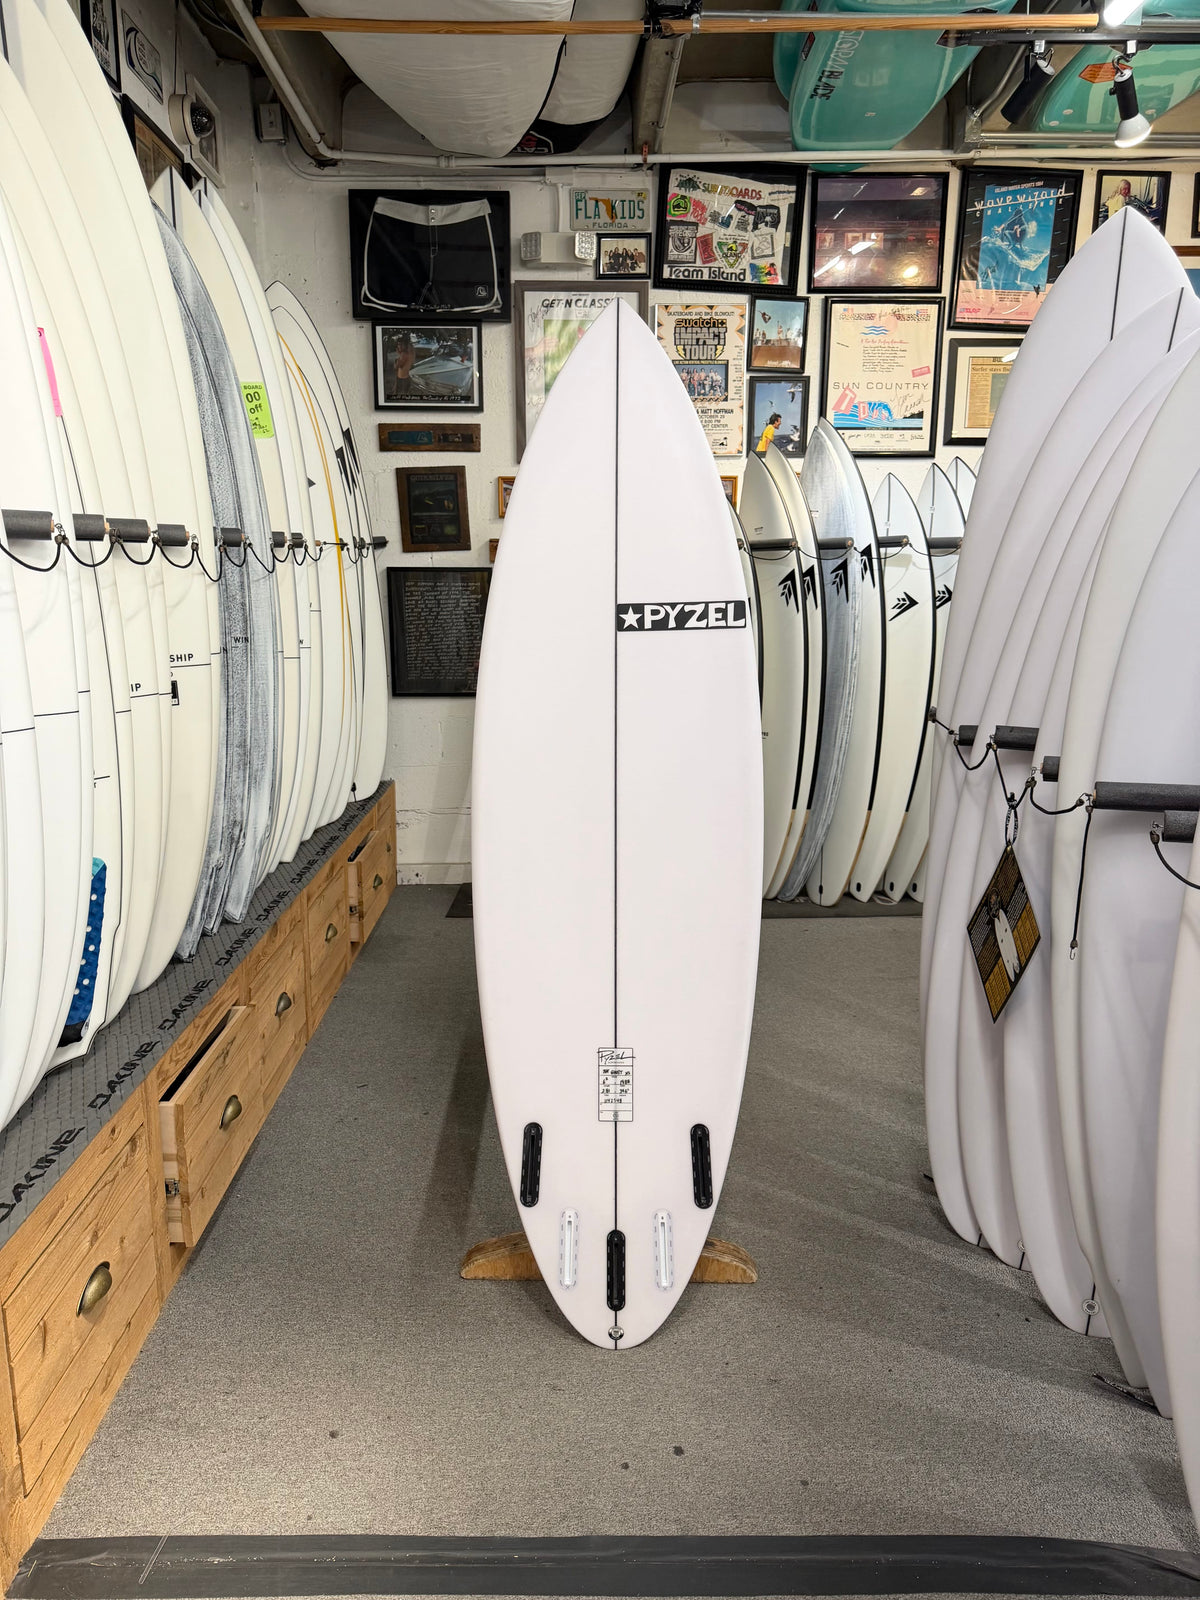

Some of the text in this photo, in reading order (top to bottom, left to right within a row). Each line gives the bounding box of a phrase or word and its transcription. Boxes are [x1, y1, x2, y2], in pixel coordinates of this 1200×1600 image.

[575, 199, 645, 220] FLA KIDS
[668, 266, 747, 281] Team Island
[675, 317, 718, 328] swatch
[674, 327, 727, 346] IMPACT
[684, 345, 716, 360] TOUR
[832, 382, 929, 391] SUN COUNTRY
[249, 403, 263, 414] off
[643, 602, 746, 630] PYZEL
[214, 925, 260, 967] DAKINE
[157, 978, 214, 1031] DAKINE
[87, 1040, 161, 1110] DAKINE
